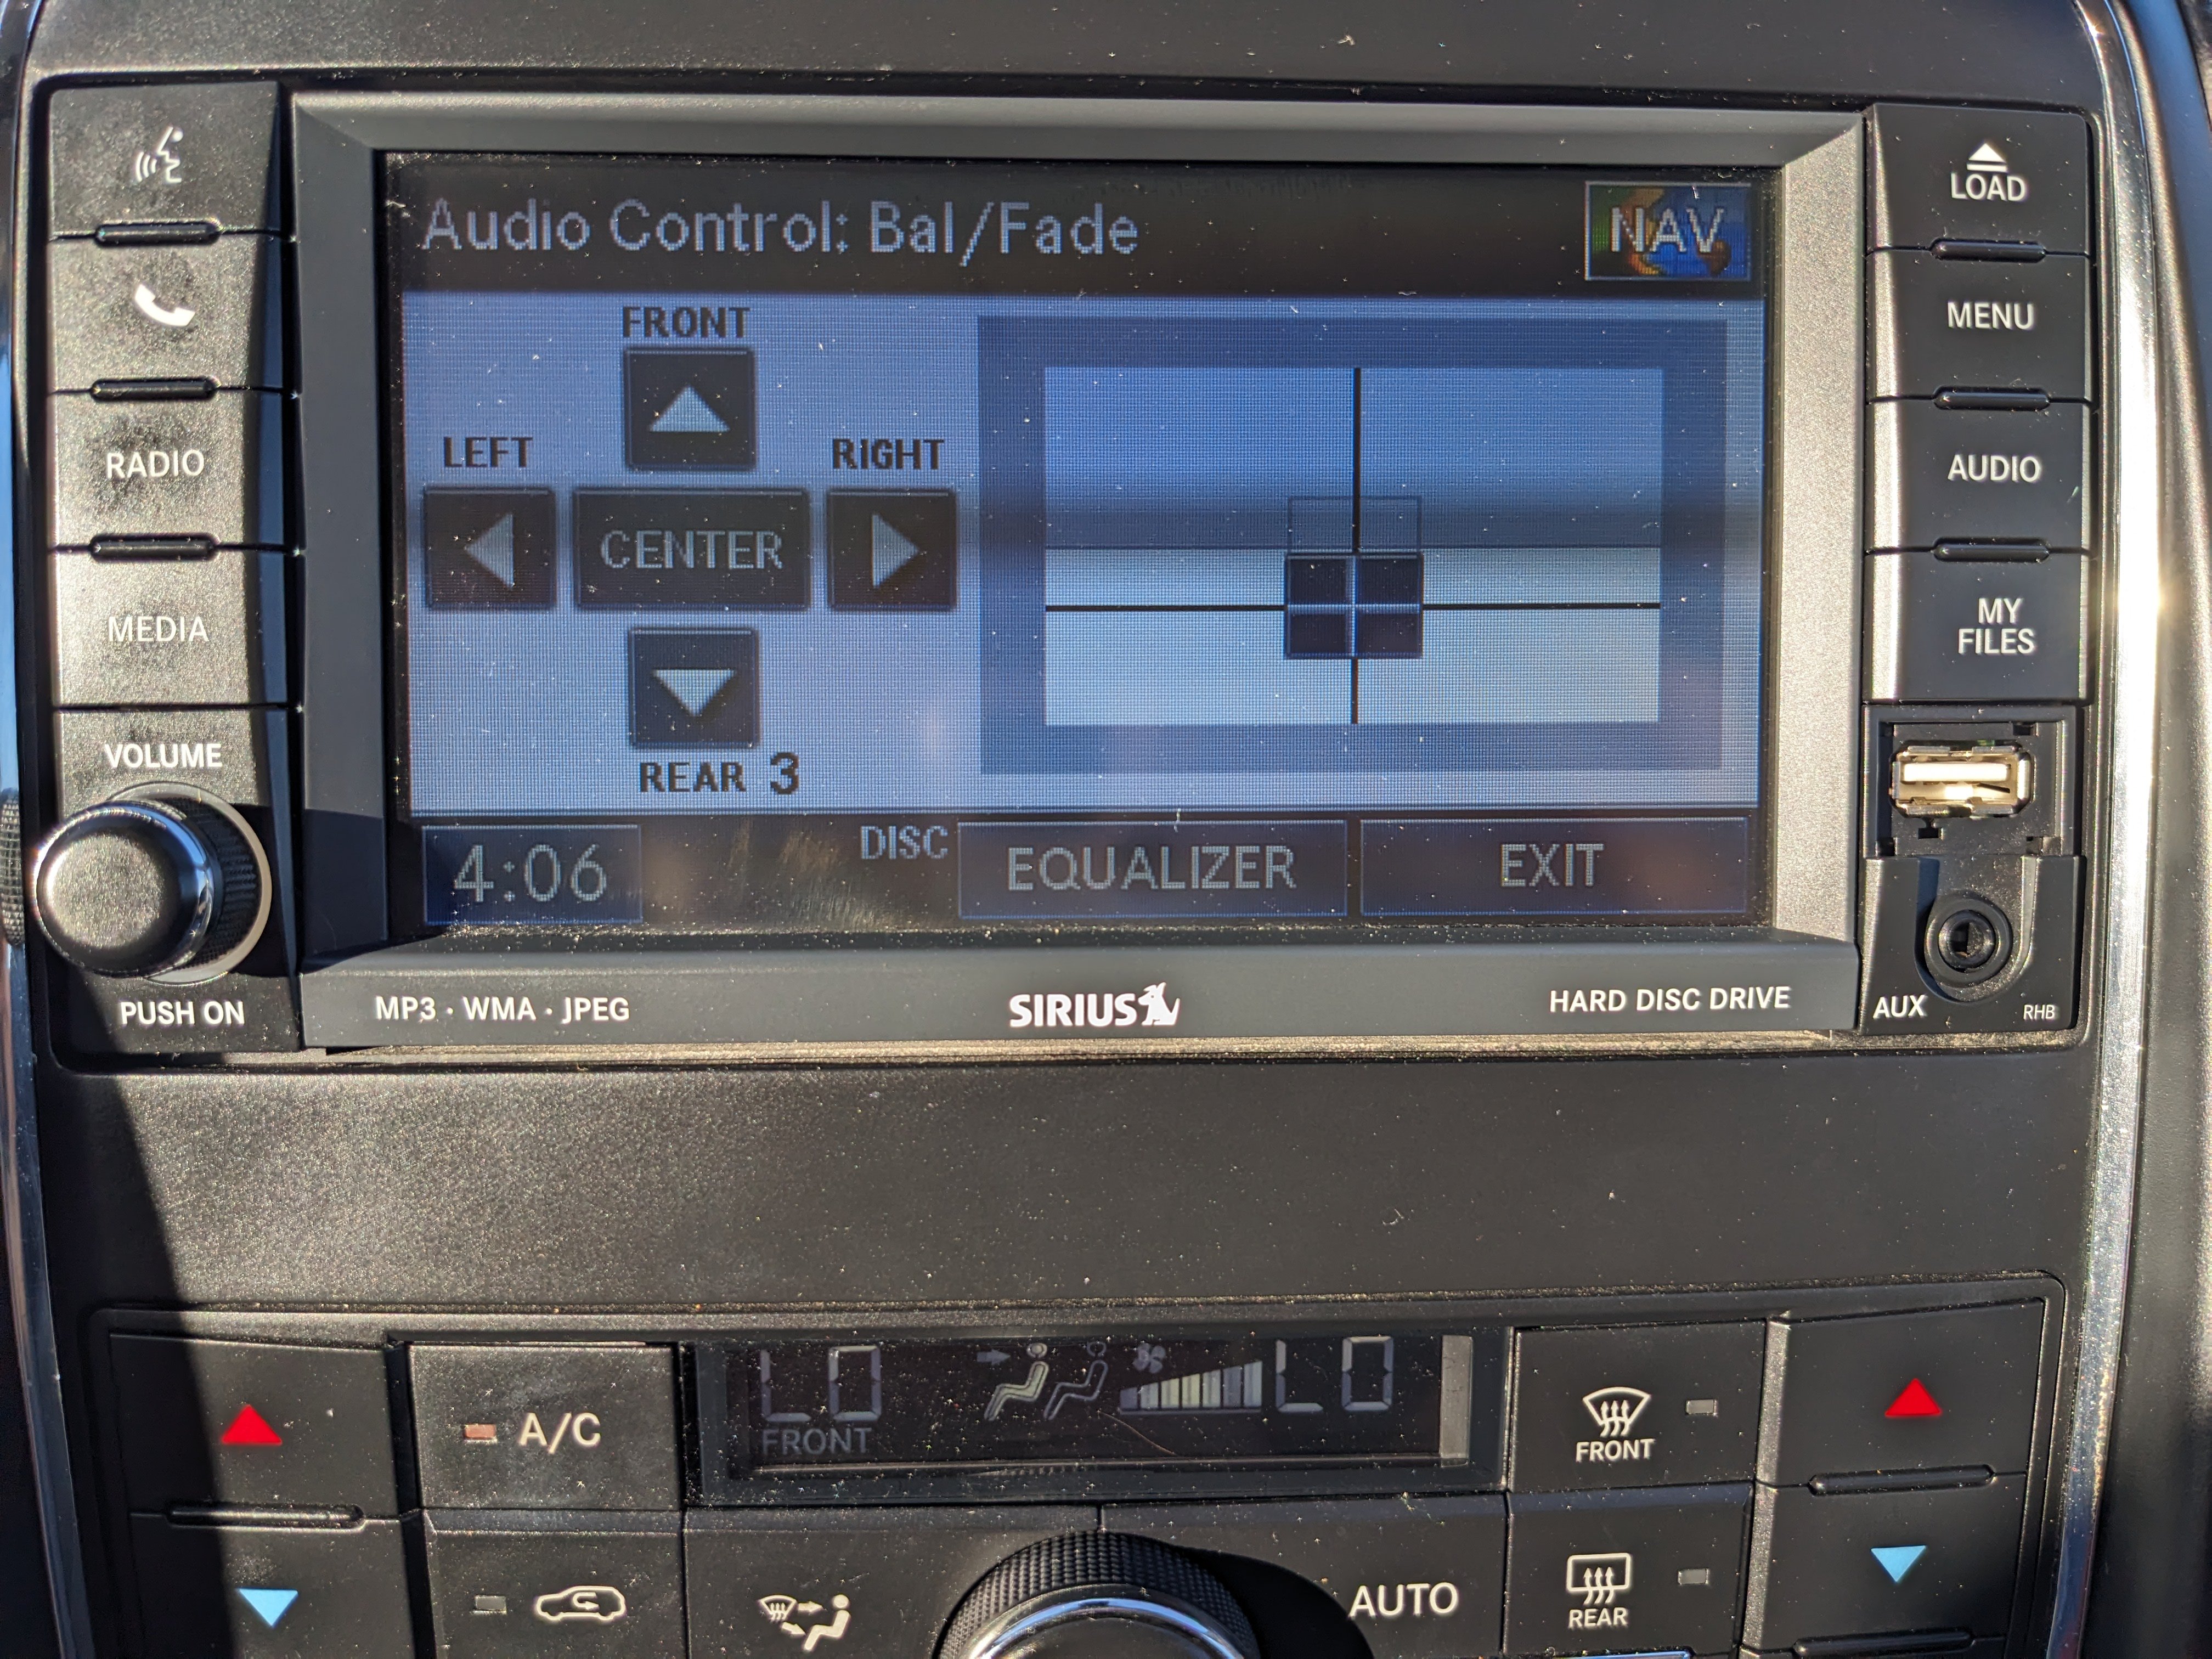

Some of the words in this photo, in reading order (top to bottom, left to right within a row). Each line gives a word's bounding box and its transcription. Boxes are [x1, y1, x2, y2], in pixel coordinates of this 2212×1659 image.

[1951, 172, 2028, 202] LOAD
[421, 198, 590, 252] Audio
[610, 200, 849, 253] Control:
[871, 201, 1139, 267] Bal/Fade
[1611, 206, 1724, 253] NAV
[622, 306, 750, 338] FRONT
[1947, 301, 2035, 330] MENU
[106, 449, 205, 478] RADIO
[443, 436, 533, 470] LEFT
[832, 437, 944, 471] RIGHT
[1948, 454, 2042, 483] AUDIO
[600, 529, 783, 571] CENTER
[1978, 598, 2023, 624] MY
[108, 615, 210, 643] MEDIA
[1957, 628, 2035, 655] FILES
[105, 742, 223, 769] VOLUME
[639, 761, 747, 793] REAR
[769, 752, 800, 795] 3
[860, 825, 948, 861] DISC
[453, 843, 607, 904] 4:06
[1008, 844, 1297, 893] EQUALIZER
[1500, 843, 1604, 889] EXIT
[121, 1001, 195, 1026] PUSH
[203, 1000, 245, 1025] ON
[376, 996, 437, 1022] MP3
[463, 997, 537, 1022] WMA
[561, 997, 630, 1024] JPEG
[1008, 991, 1138, 1028] SIRIUS
[1549, 989, 1627, 1014] HARD
[1635, 988, 1702, 1013] DISC
[1709, 986, 1792, 1011] DRIVE
[1872, 995, 1927, 1019] AUX
[2023, 1004, 2057, 1021] RHB
[518, 1412, 601, 1455] A/C
[763, 1427, 872, 1456] FRONT
[1575, 1437, 1655, 1463] FRONT
[1349, 1581, 1459, 1619] AUTO
[1567, 1606, 1628, 1629] REAR
